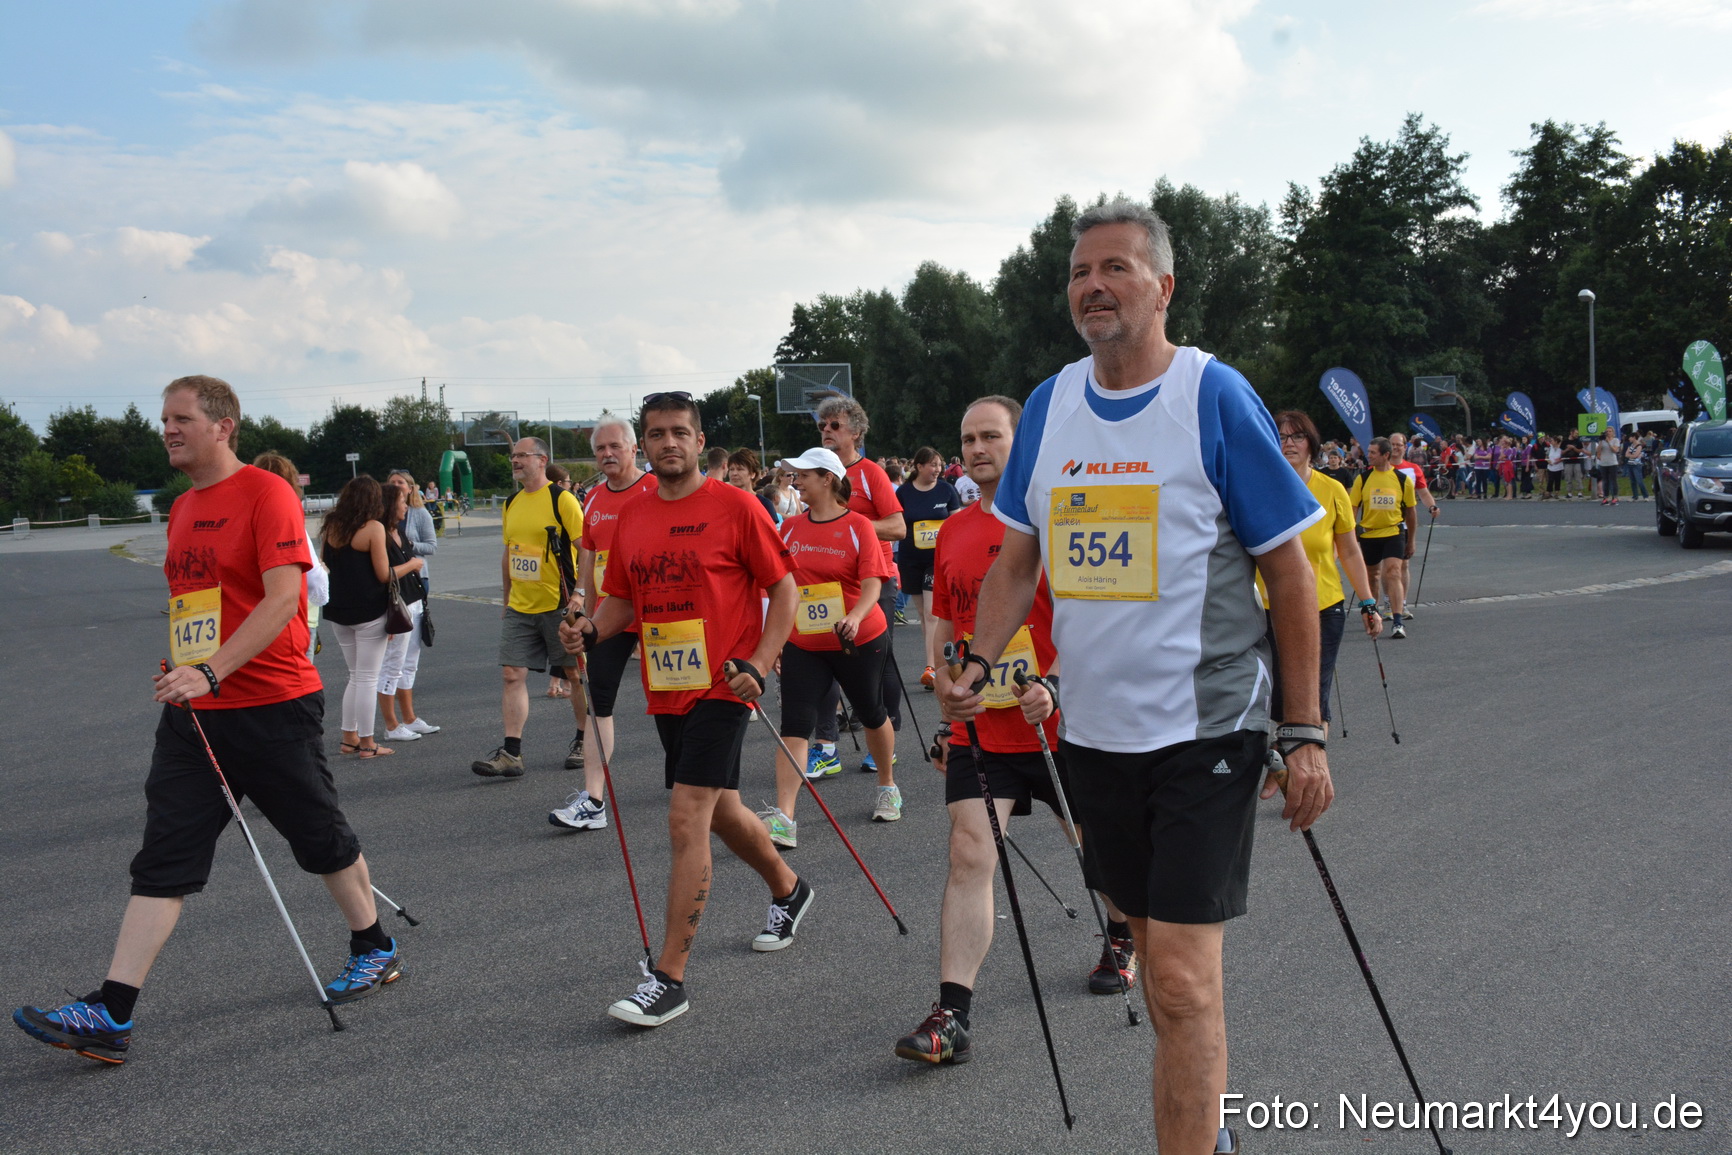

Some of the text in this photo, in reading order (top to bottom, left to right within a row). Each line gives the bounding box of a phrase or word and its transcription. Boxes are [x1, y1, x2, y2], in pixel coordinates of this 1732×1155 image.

[1086, 461, 1154, 475] KLEBL
[1063, 503, 1099, 513] firmenlauf
[1372, 496, 1394, 505] 1283
[1054, 517, 1081, 527] walken
[801, 544, 846, 559] bfwnürnberg
[1068, 531, 1133, 568] 554
[511, 557, 538, 573] 1280
[1093, 576, 1117, 585] Häring
[642, 601, 695, 615] Alles läuft
[807, 603, 828, 620] 89
[175, 618, 216, 648] 1473
[651, 648, 702, 671] 1474
[976, 772, 1003, 847] EASY WAY
[1316, 861, 1346, 923] EASY WAY
